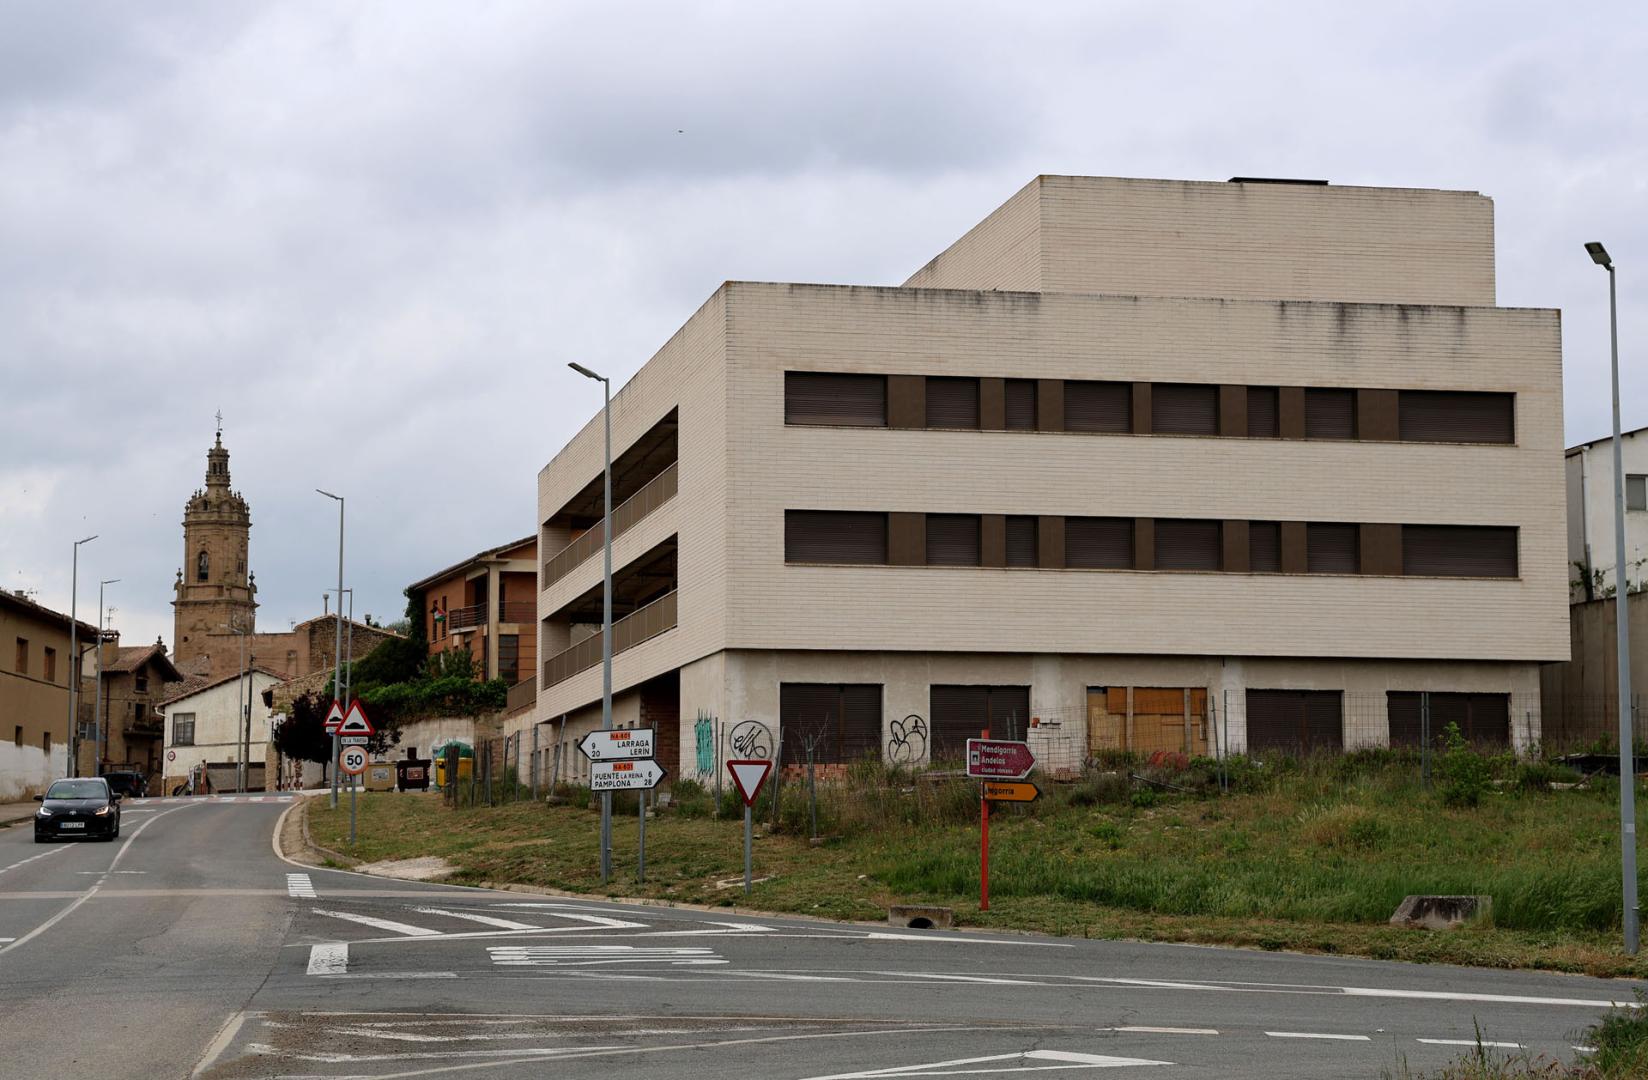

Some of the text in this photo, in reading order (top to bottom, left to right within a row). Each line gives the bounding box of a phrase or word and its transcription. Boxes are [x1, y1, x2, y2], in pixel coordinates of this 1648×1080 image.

[347, 754, 363, 766] 50
[981, 756, 1006, 764] Andelos
[594, 780, 631, 788] PAMPLONA
